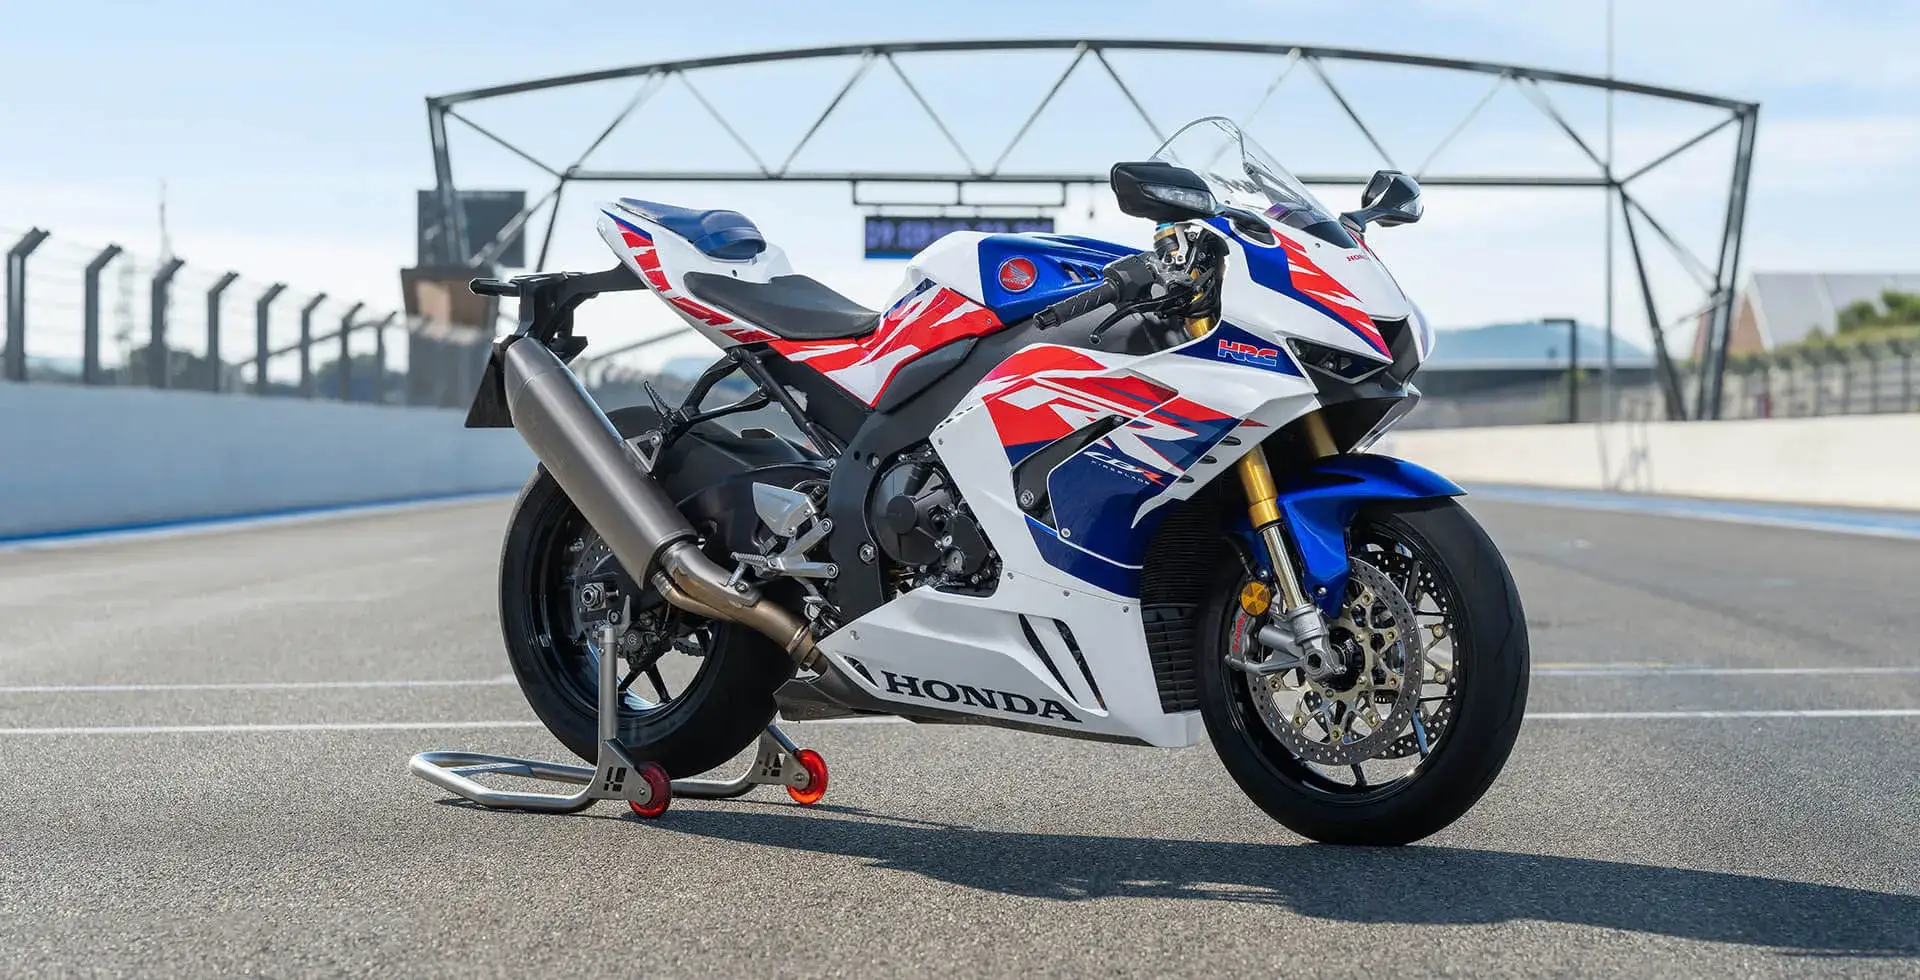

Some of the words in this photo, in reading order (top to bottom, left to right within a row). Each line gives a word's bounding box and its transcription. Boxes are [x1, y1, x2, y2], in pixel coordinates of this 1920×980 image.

[1217, 339, 1278, 367] HRC
[1083, 451, 1166, 487] CBR
[880, 670, 1083, 723] HONDA
